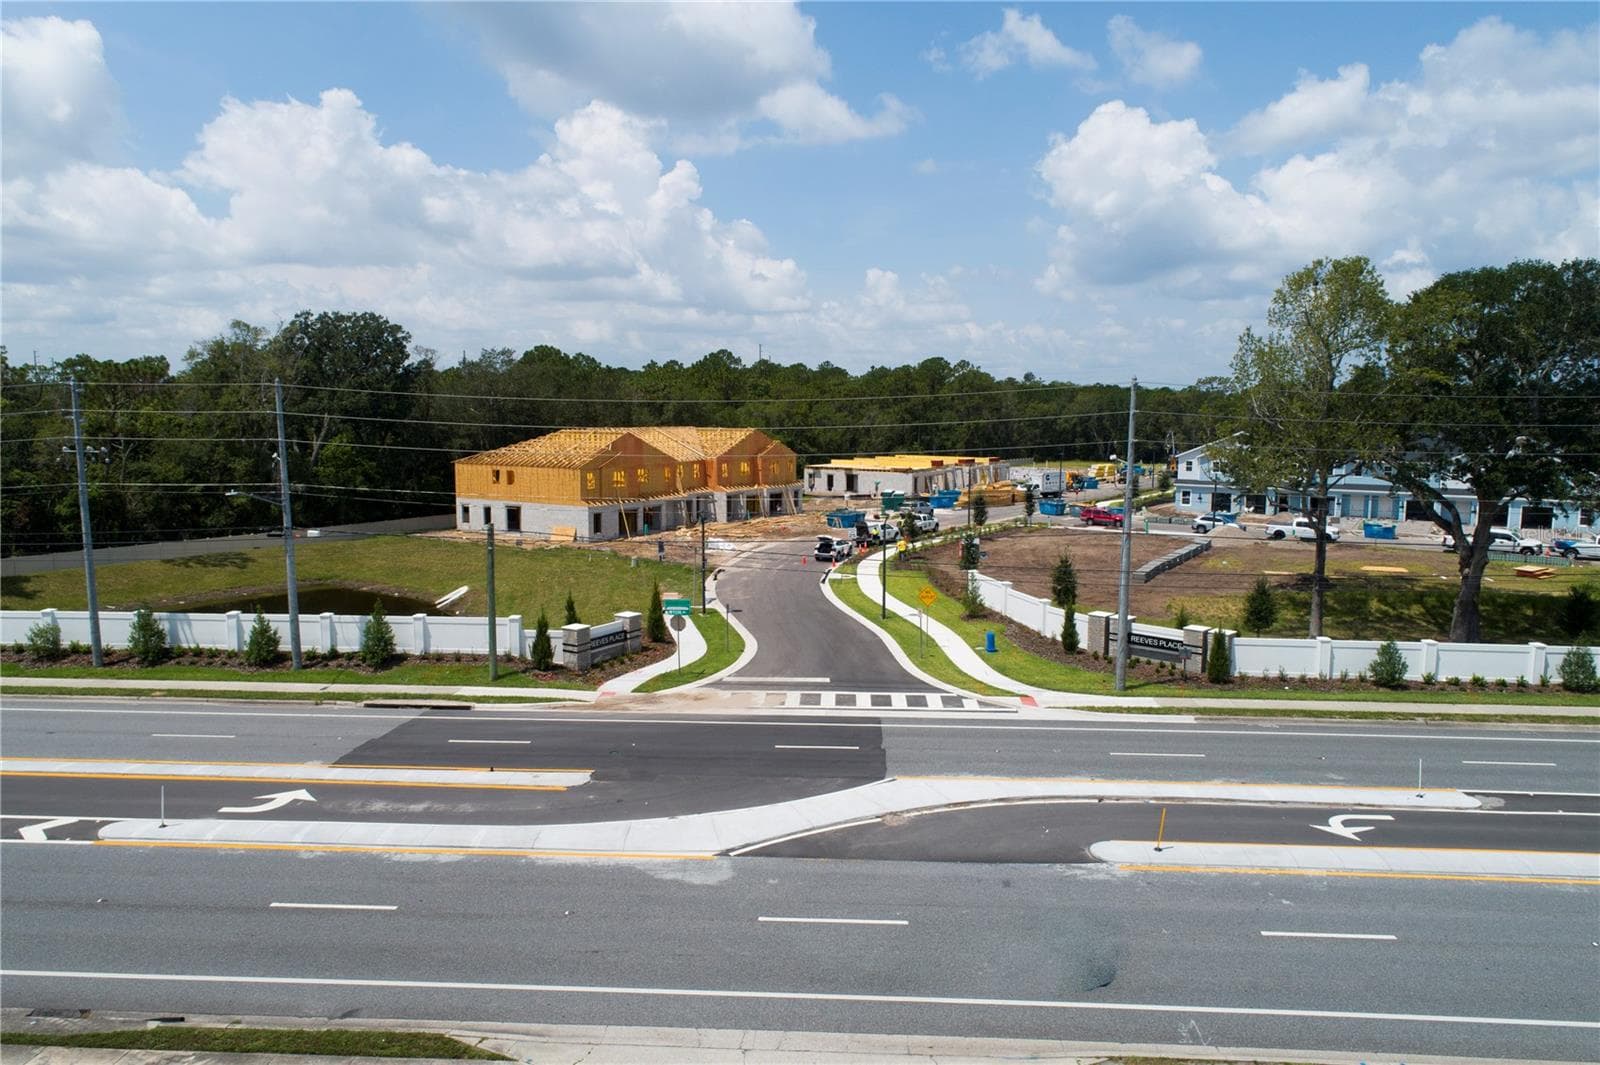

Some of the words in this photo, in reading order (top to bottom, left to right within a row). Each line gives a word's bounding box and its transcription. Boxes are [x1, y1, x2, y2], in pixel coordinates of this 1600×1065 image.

[609, 632, 625, 642] PLACE
[1130, 635, 1158, 646] REEVES
[1159, 640, 1183, 650] PLACE
